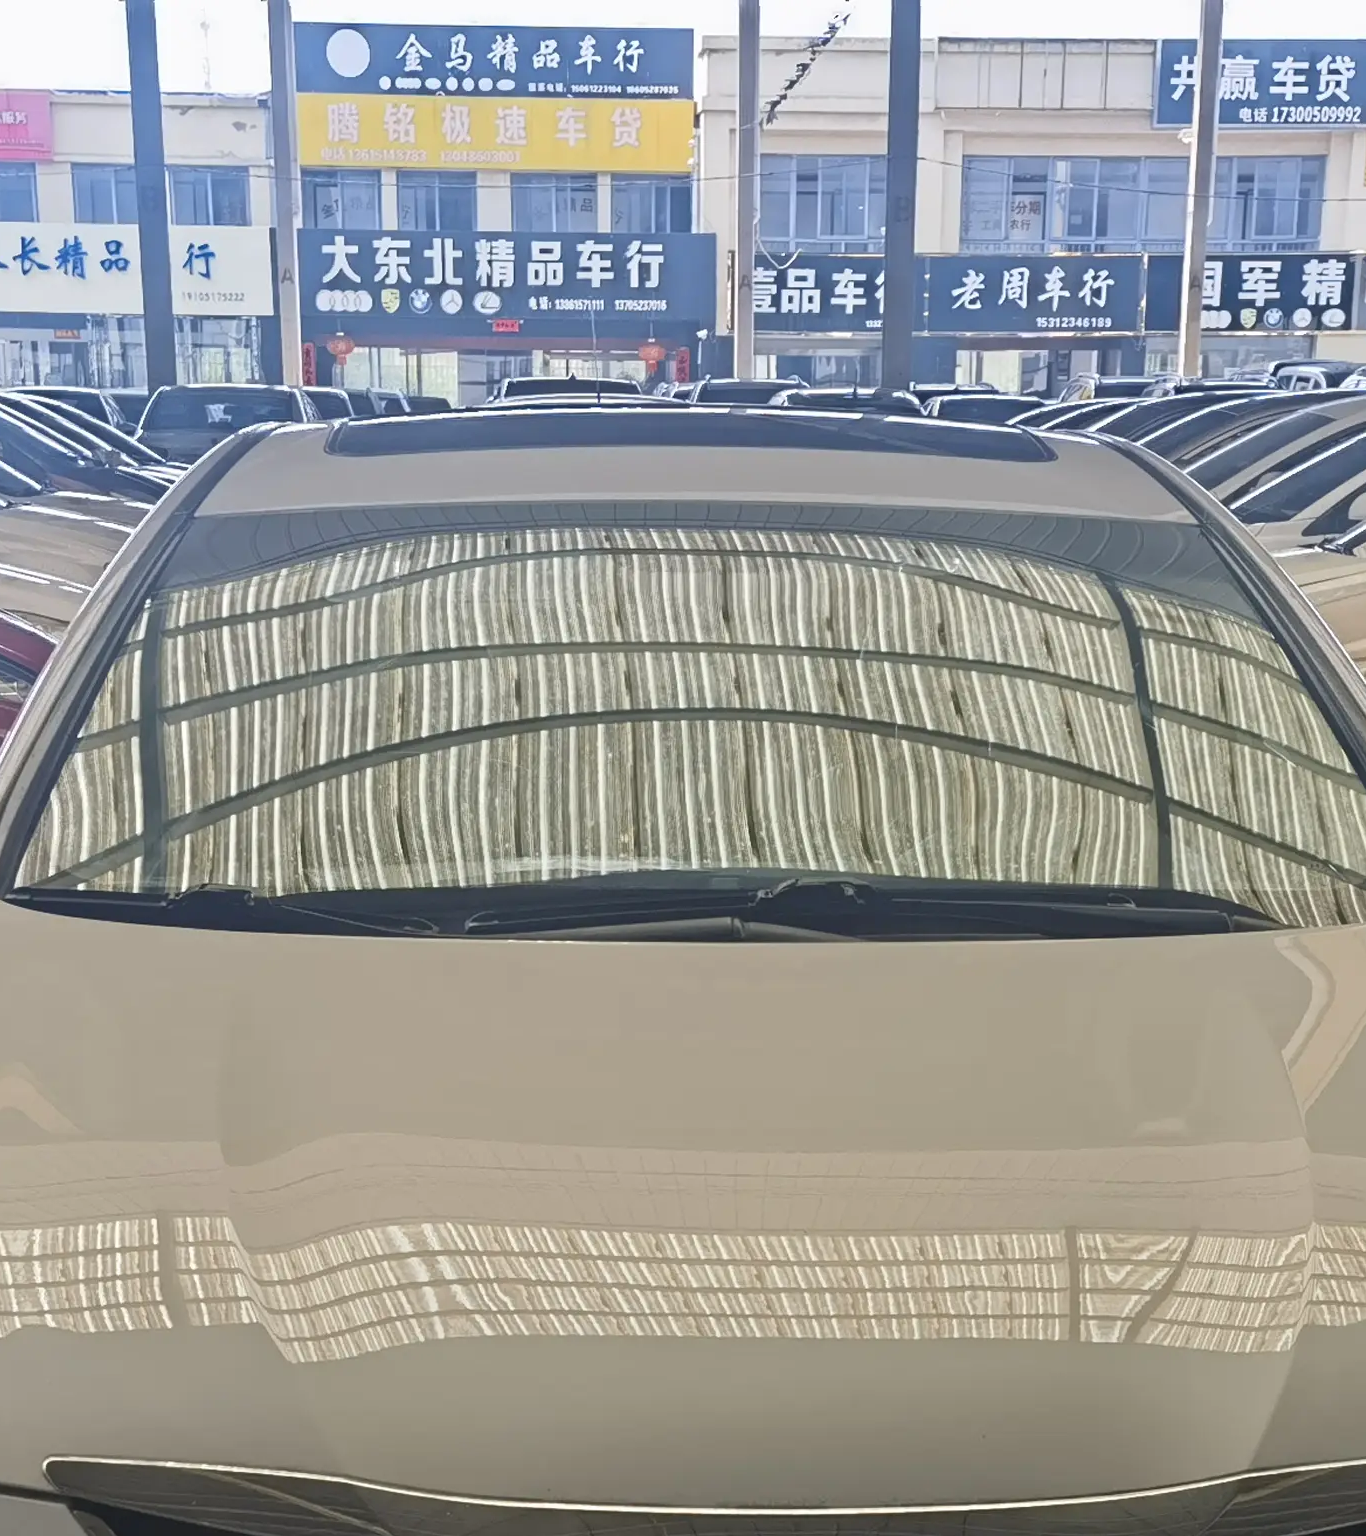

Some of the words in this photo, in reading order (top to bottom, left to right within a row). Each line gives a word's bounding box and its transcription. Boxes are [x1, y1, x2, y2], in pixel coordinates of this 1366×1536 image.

[395, 33, 646, 75] 金马精品车行
[1170, 55, 1357, 102] 共赢车贷
[327, 103, 642, 149] 腾铭极速车贷
[1239, 107, 1268, 123] 电话
[1271, 105, 1362, 123] 17300509992
[321, 235, 666, 288] 大东北精品车行
[753, 267, 885, 315] 壹品车
[951, 265, 1115, 312] 老周车行
[1035, 316, 1112, 328] 15312346189
